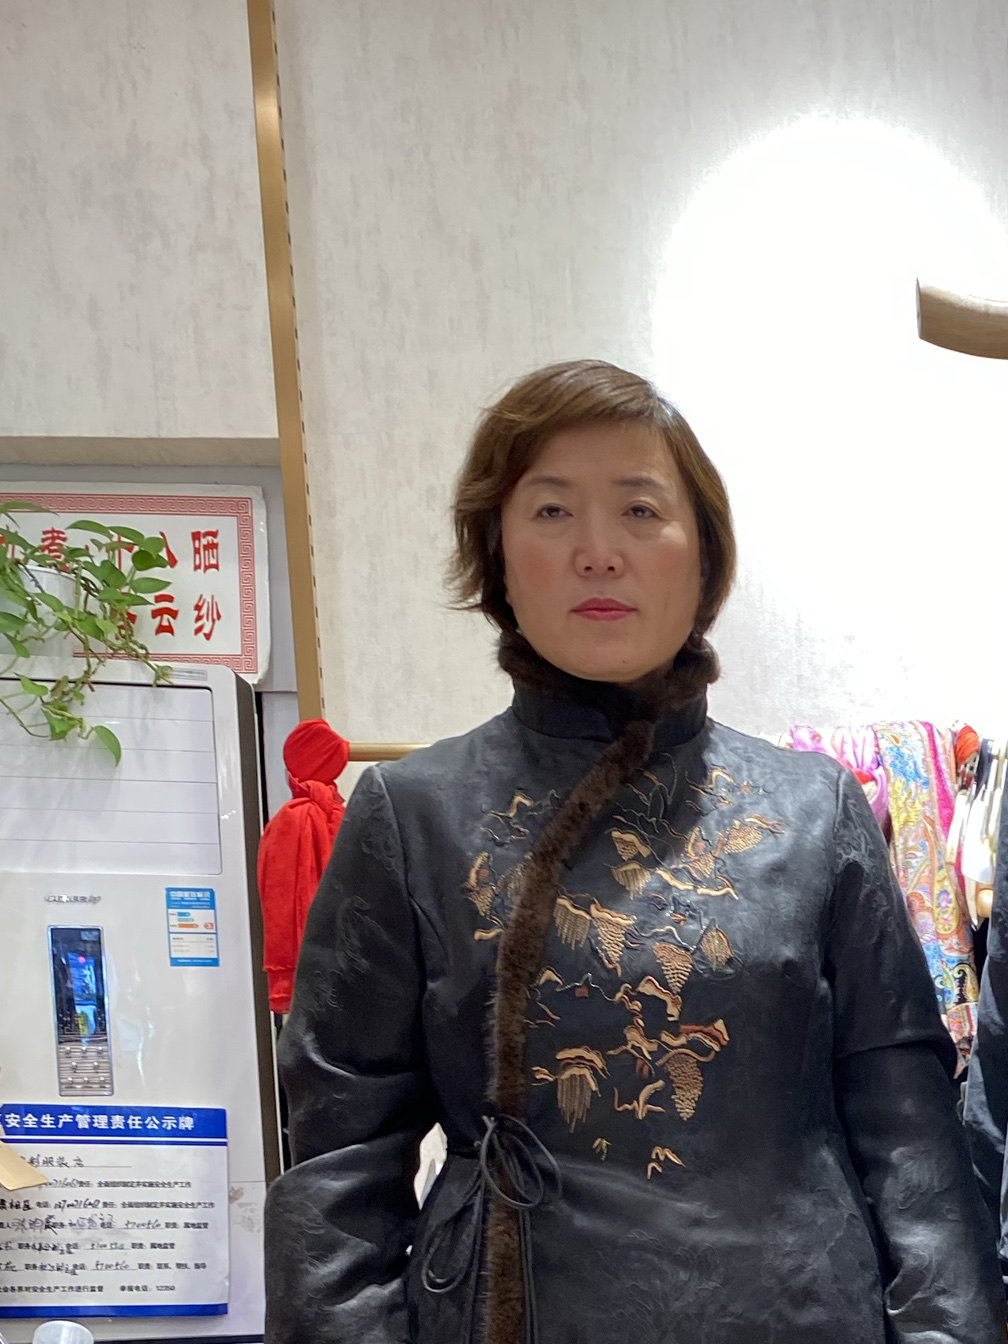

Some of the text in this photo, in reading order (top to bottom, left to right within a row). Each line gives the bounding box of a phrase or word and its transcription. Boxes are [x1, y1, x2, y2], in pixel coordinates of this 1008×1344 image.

[4, 1113, 195, 1131] 安全生产管理责任公示牌
